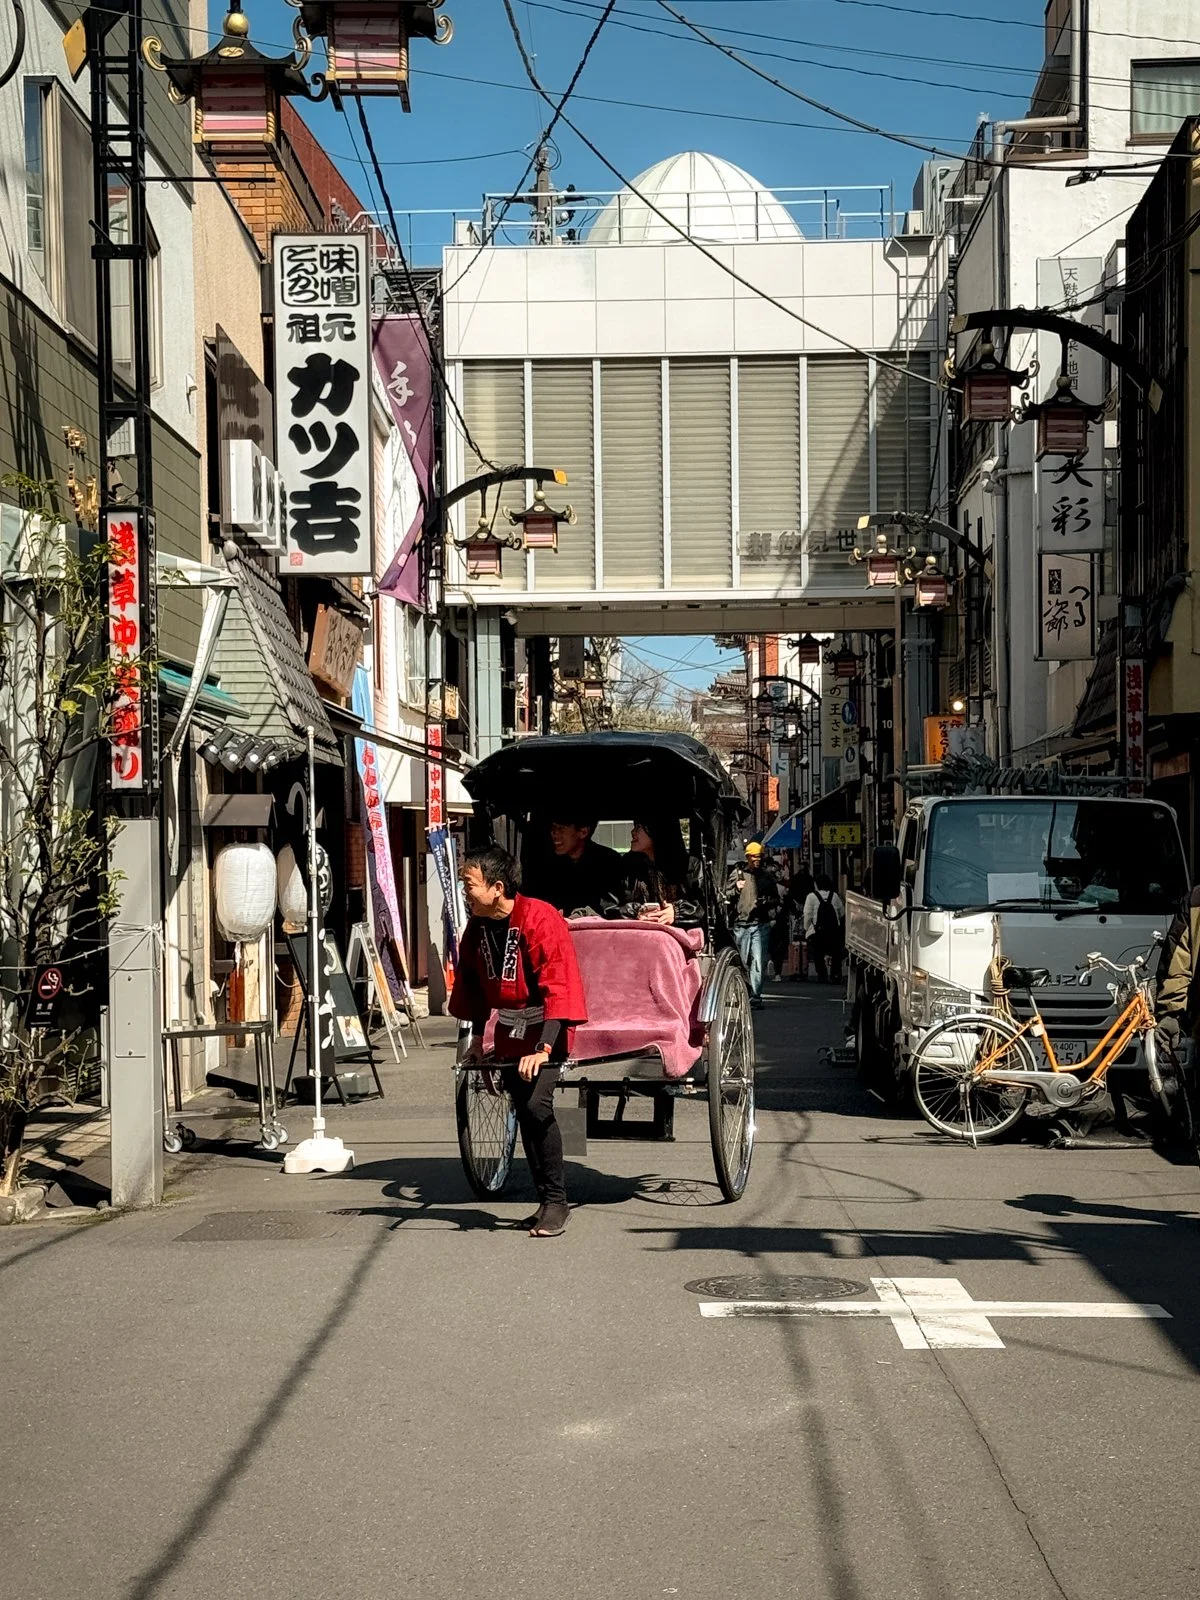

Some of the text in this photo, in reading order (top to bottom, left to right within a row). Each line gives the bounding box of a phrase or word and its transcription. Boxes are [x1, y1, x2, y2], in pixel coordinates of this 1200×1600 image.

[286, 247, 320, 304] とんかつ
[319, 247, 356, 304] 味噌
[287, 352, 362, 556] カツ吉
[881, 719, 894, 730] 10
[1059, 1043, 1074, 1051] 400
